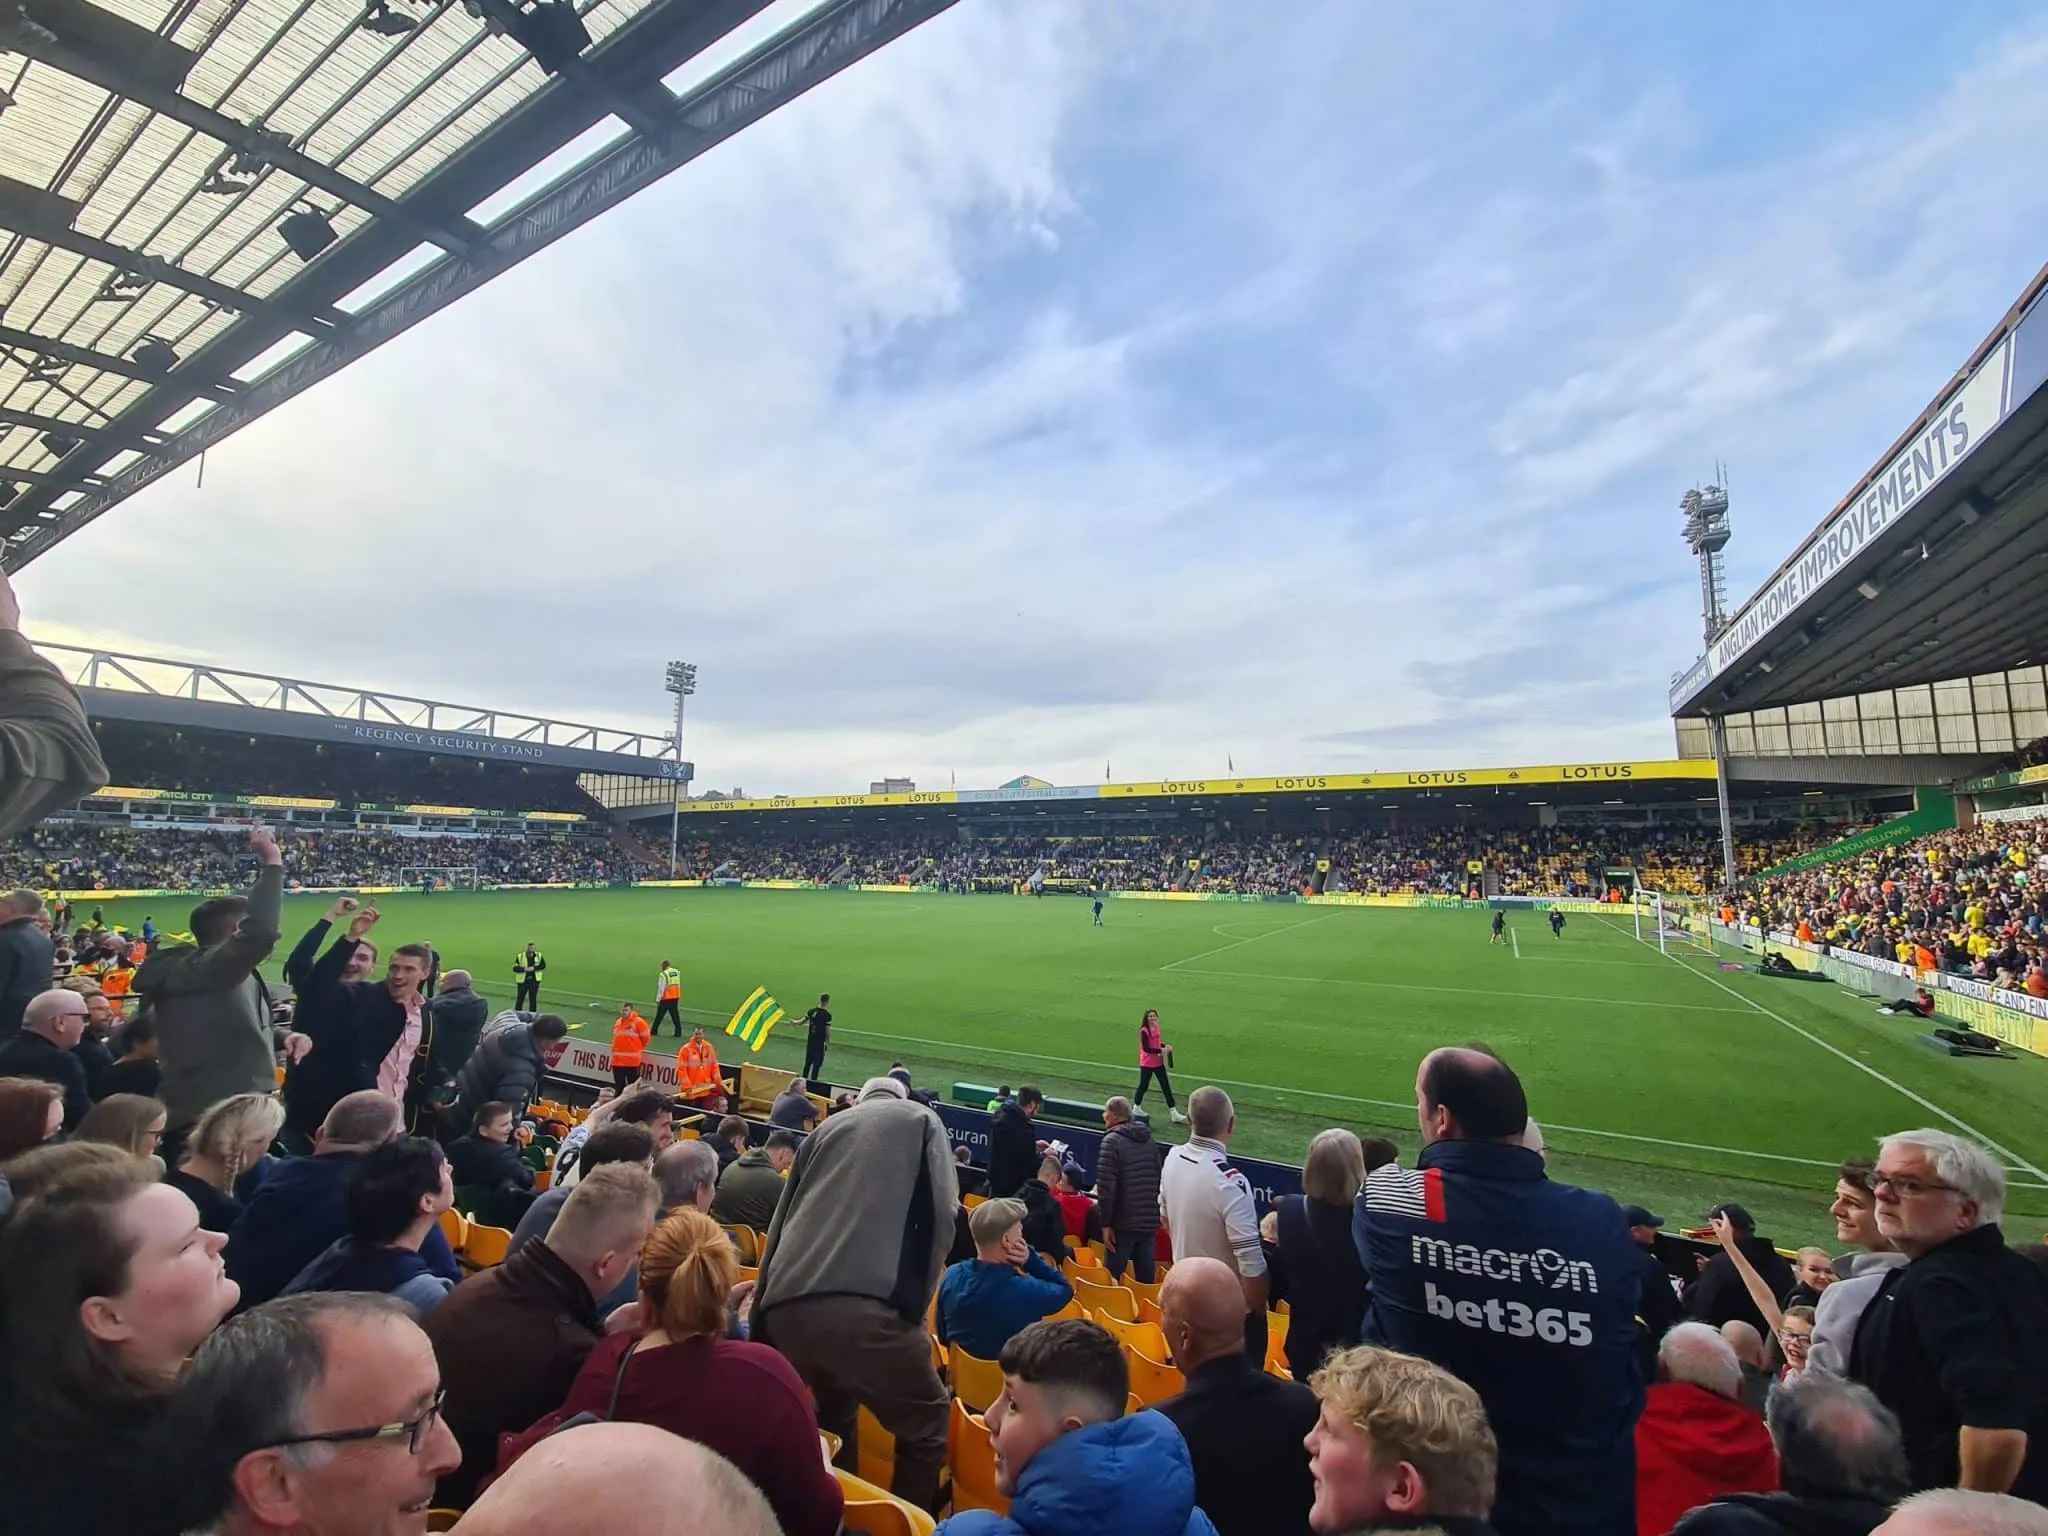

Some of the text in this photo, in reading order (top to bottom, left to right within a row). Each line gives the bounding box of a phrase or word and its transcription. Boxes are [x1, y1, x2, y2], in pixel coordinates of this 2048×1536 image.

[1719, 401, 1969, 668] ANGLIAN HOME IMPROVEMENTS
[354, 726, 423, 744] REGENCY
[429, 735, 497, 752] SECURITY
[502, 744, 543, 758] STAND
[1407, 771, 1468, 785] LOTUS
[1561, 765, 1633, 780] LOTUS
[1160, 782, 1206, 794] LOTUS
[1274, 777, 1327, 789] LOTUS
[191, 792, 214, 801] CITY
[769, 799, 796, 808] LOTUS
[835, 796, 865, 806] LOTUS
[908, 793, 942, 803] LOTUS
[710, 801, 735, 810] LOTUS
[1951, 979, 2000, 1000] INSURANE
[2004, 993, 2026, 1011] AND
[572, 1049, 597, 1070] THIS
[598, 1054, 612, 1073] BU
[639, 1062, 654, 1082] OR
[947, 1127, 988, 1146] suran
[1411, 1234, 1599, 1293] macron
[1423, 1281, 1594, 1347] bet365
